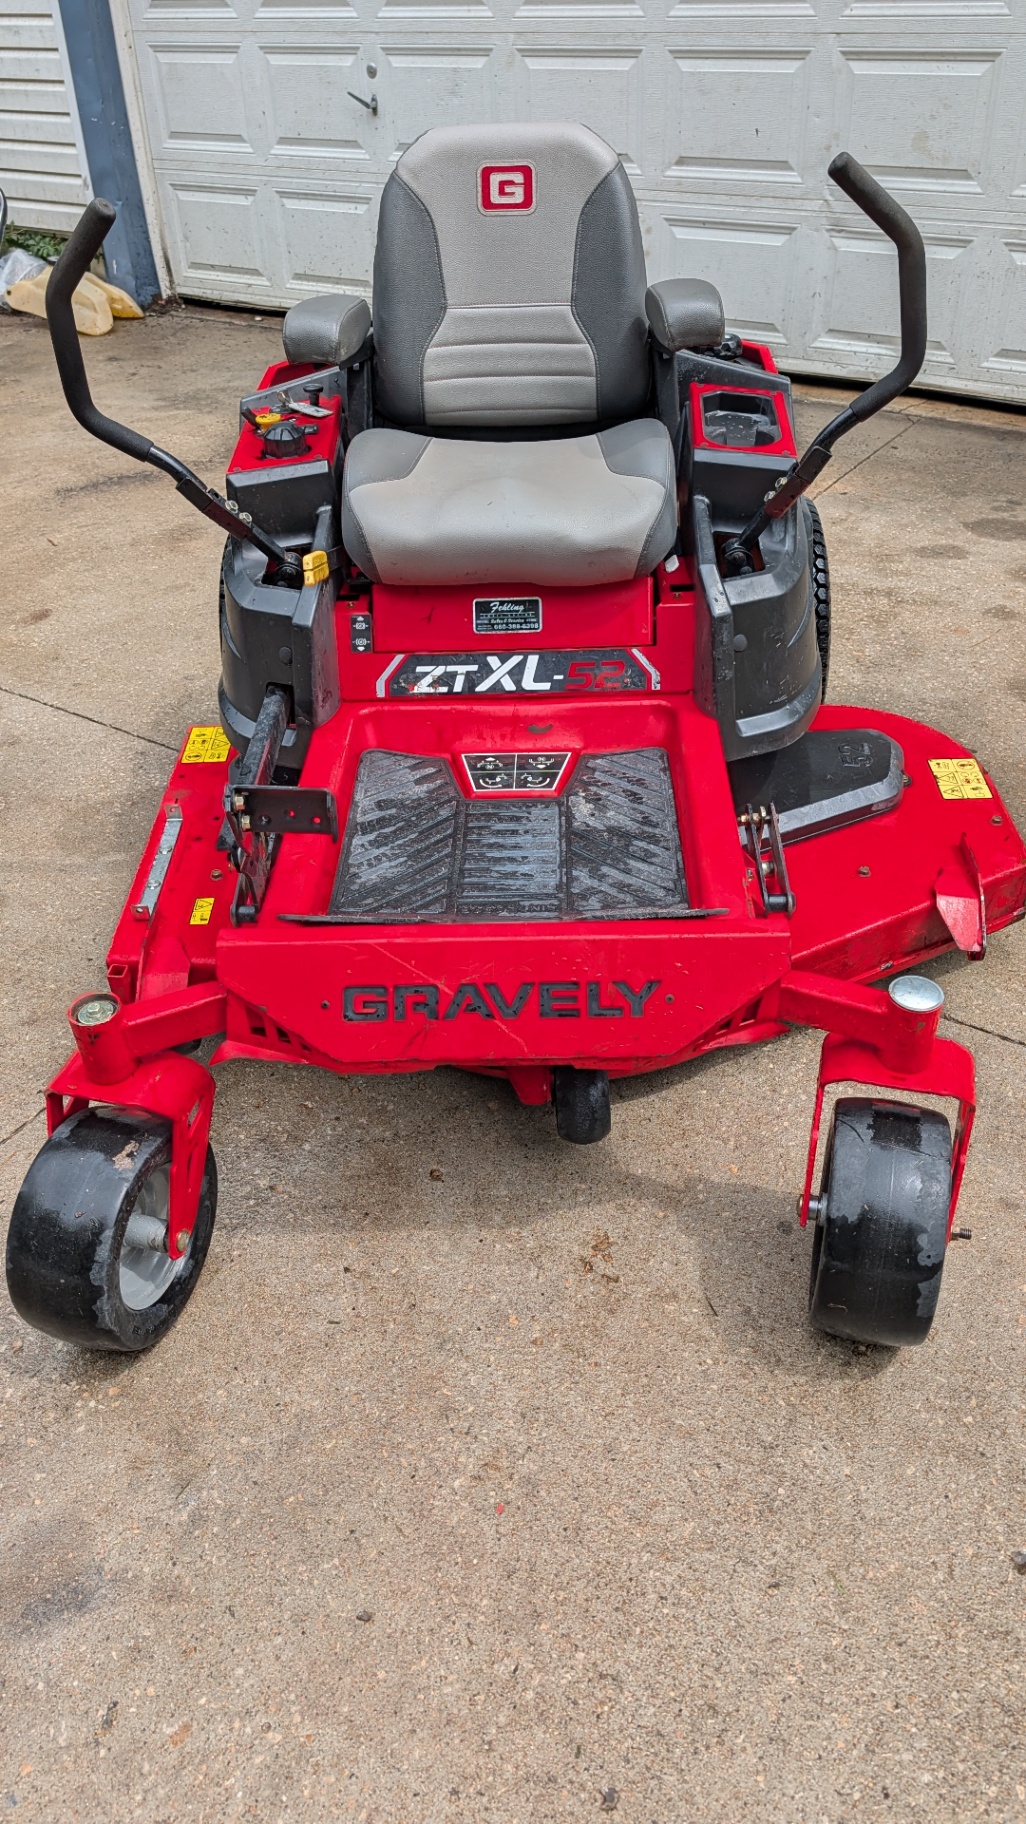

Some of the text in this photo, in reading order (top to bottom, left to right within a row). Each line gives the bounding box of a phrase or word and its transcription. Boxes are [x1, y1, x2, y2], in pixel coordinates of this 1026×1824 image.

[489, 172, 525, 204] G
[490, 601, 525, 613] Fehling
[342, 980, 661, 1021] GRAVELY
